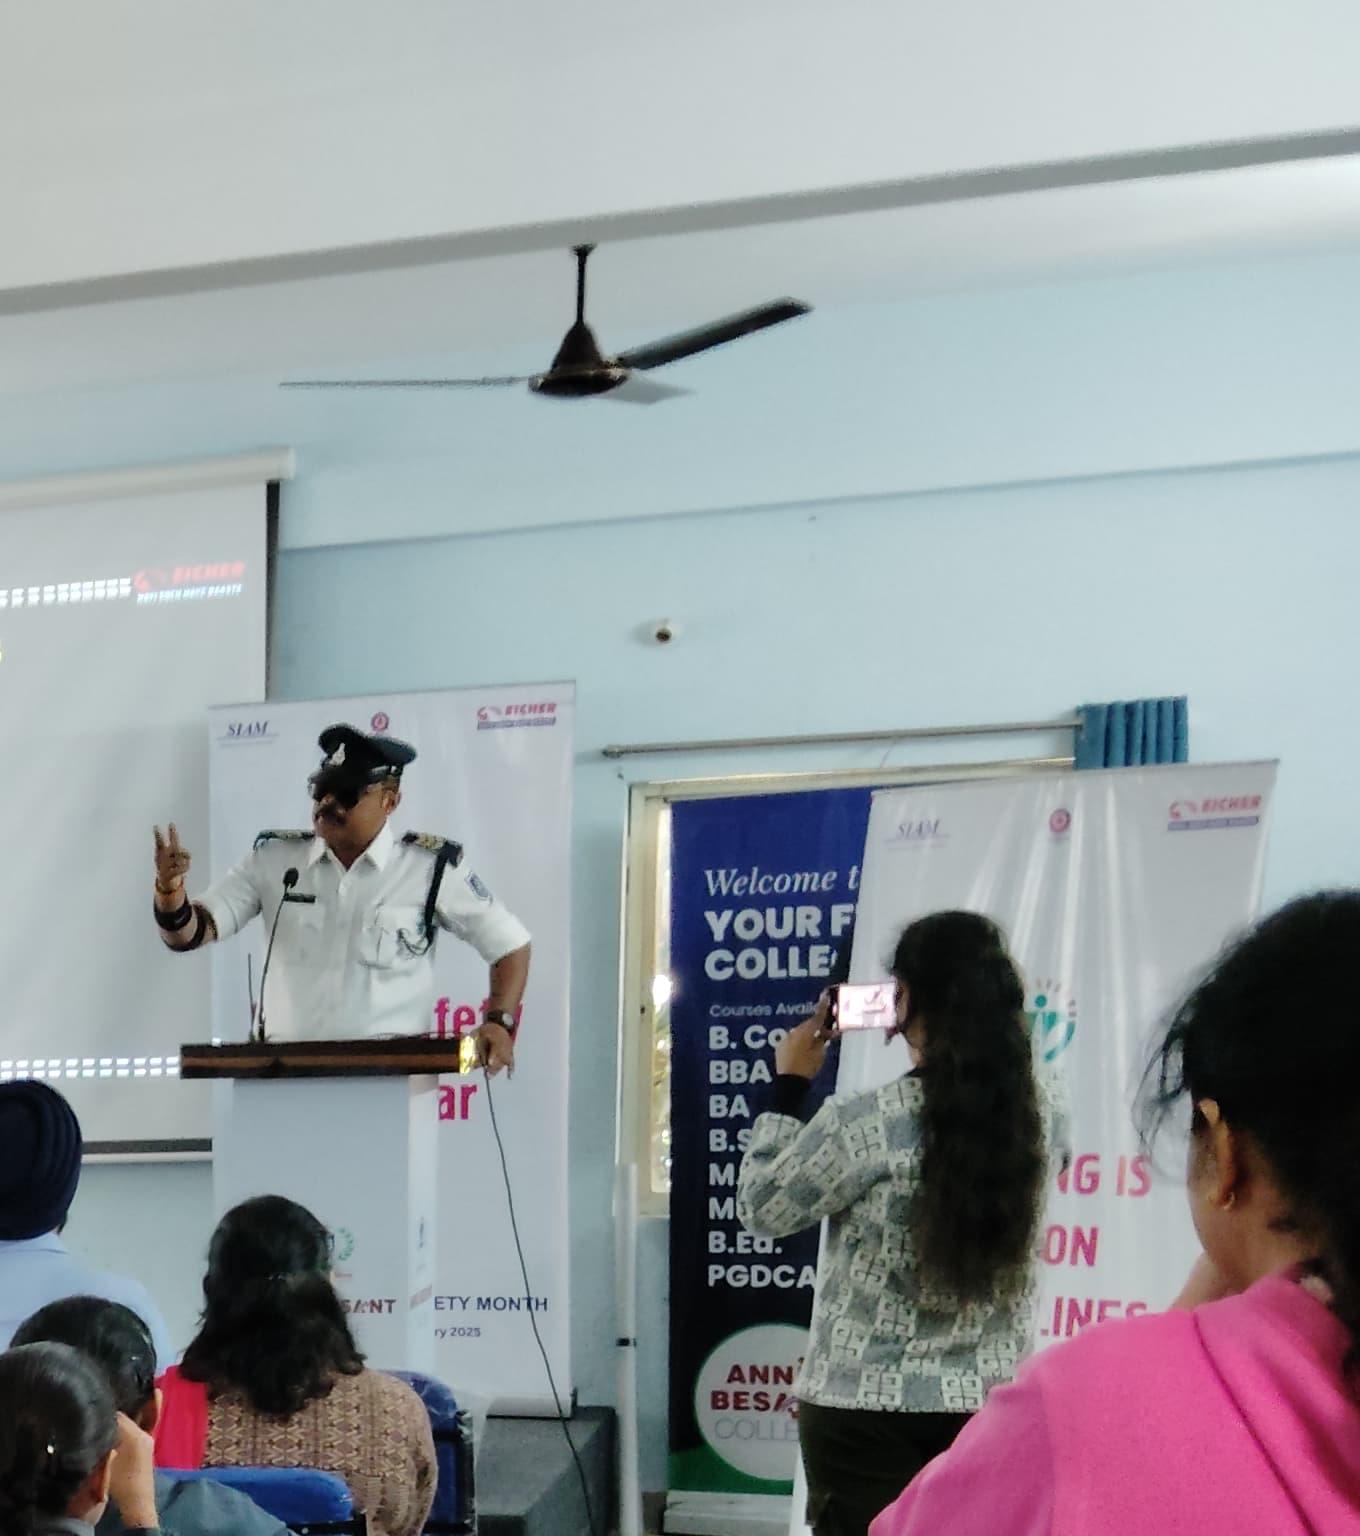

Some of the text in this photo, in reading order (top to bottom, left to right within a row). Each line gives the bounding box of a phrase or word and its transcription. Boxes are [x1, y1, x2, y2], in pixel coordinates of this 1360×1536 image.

[227, 720, 270, 737] SIAM
[897, 820, 940, 838] SIAM
[704, 864, 860, 897] Welcome t
[703, 902, 855, 943] YOUR F
[704, 944, 838, 981] COLLE
[709, 1001, 817, 1018] Courses Avail
[709, 1024, 786, 1051] B. Co
[709, 1060, 773, 1085] BBA
[438, 1084, 478, 1121] ar
[709, 1094, 750, 1120] BA
[709, 1128, 753, 1153] B.S
[1116, 1154, 1153, 1197] IS
[708, 1264, 817, 1289] PGDCA
[341, 1298, 398, 1314] SANT
[434, 1295, 549, 1312] ETY MONTH
[450, 1326, 482, 1338] 2025
[726, 1364, 794, 1386] ANN
[710, 1390, 800, 1418] BESA
[714, 1418, 800, 1441] COLLE
